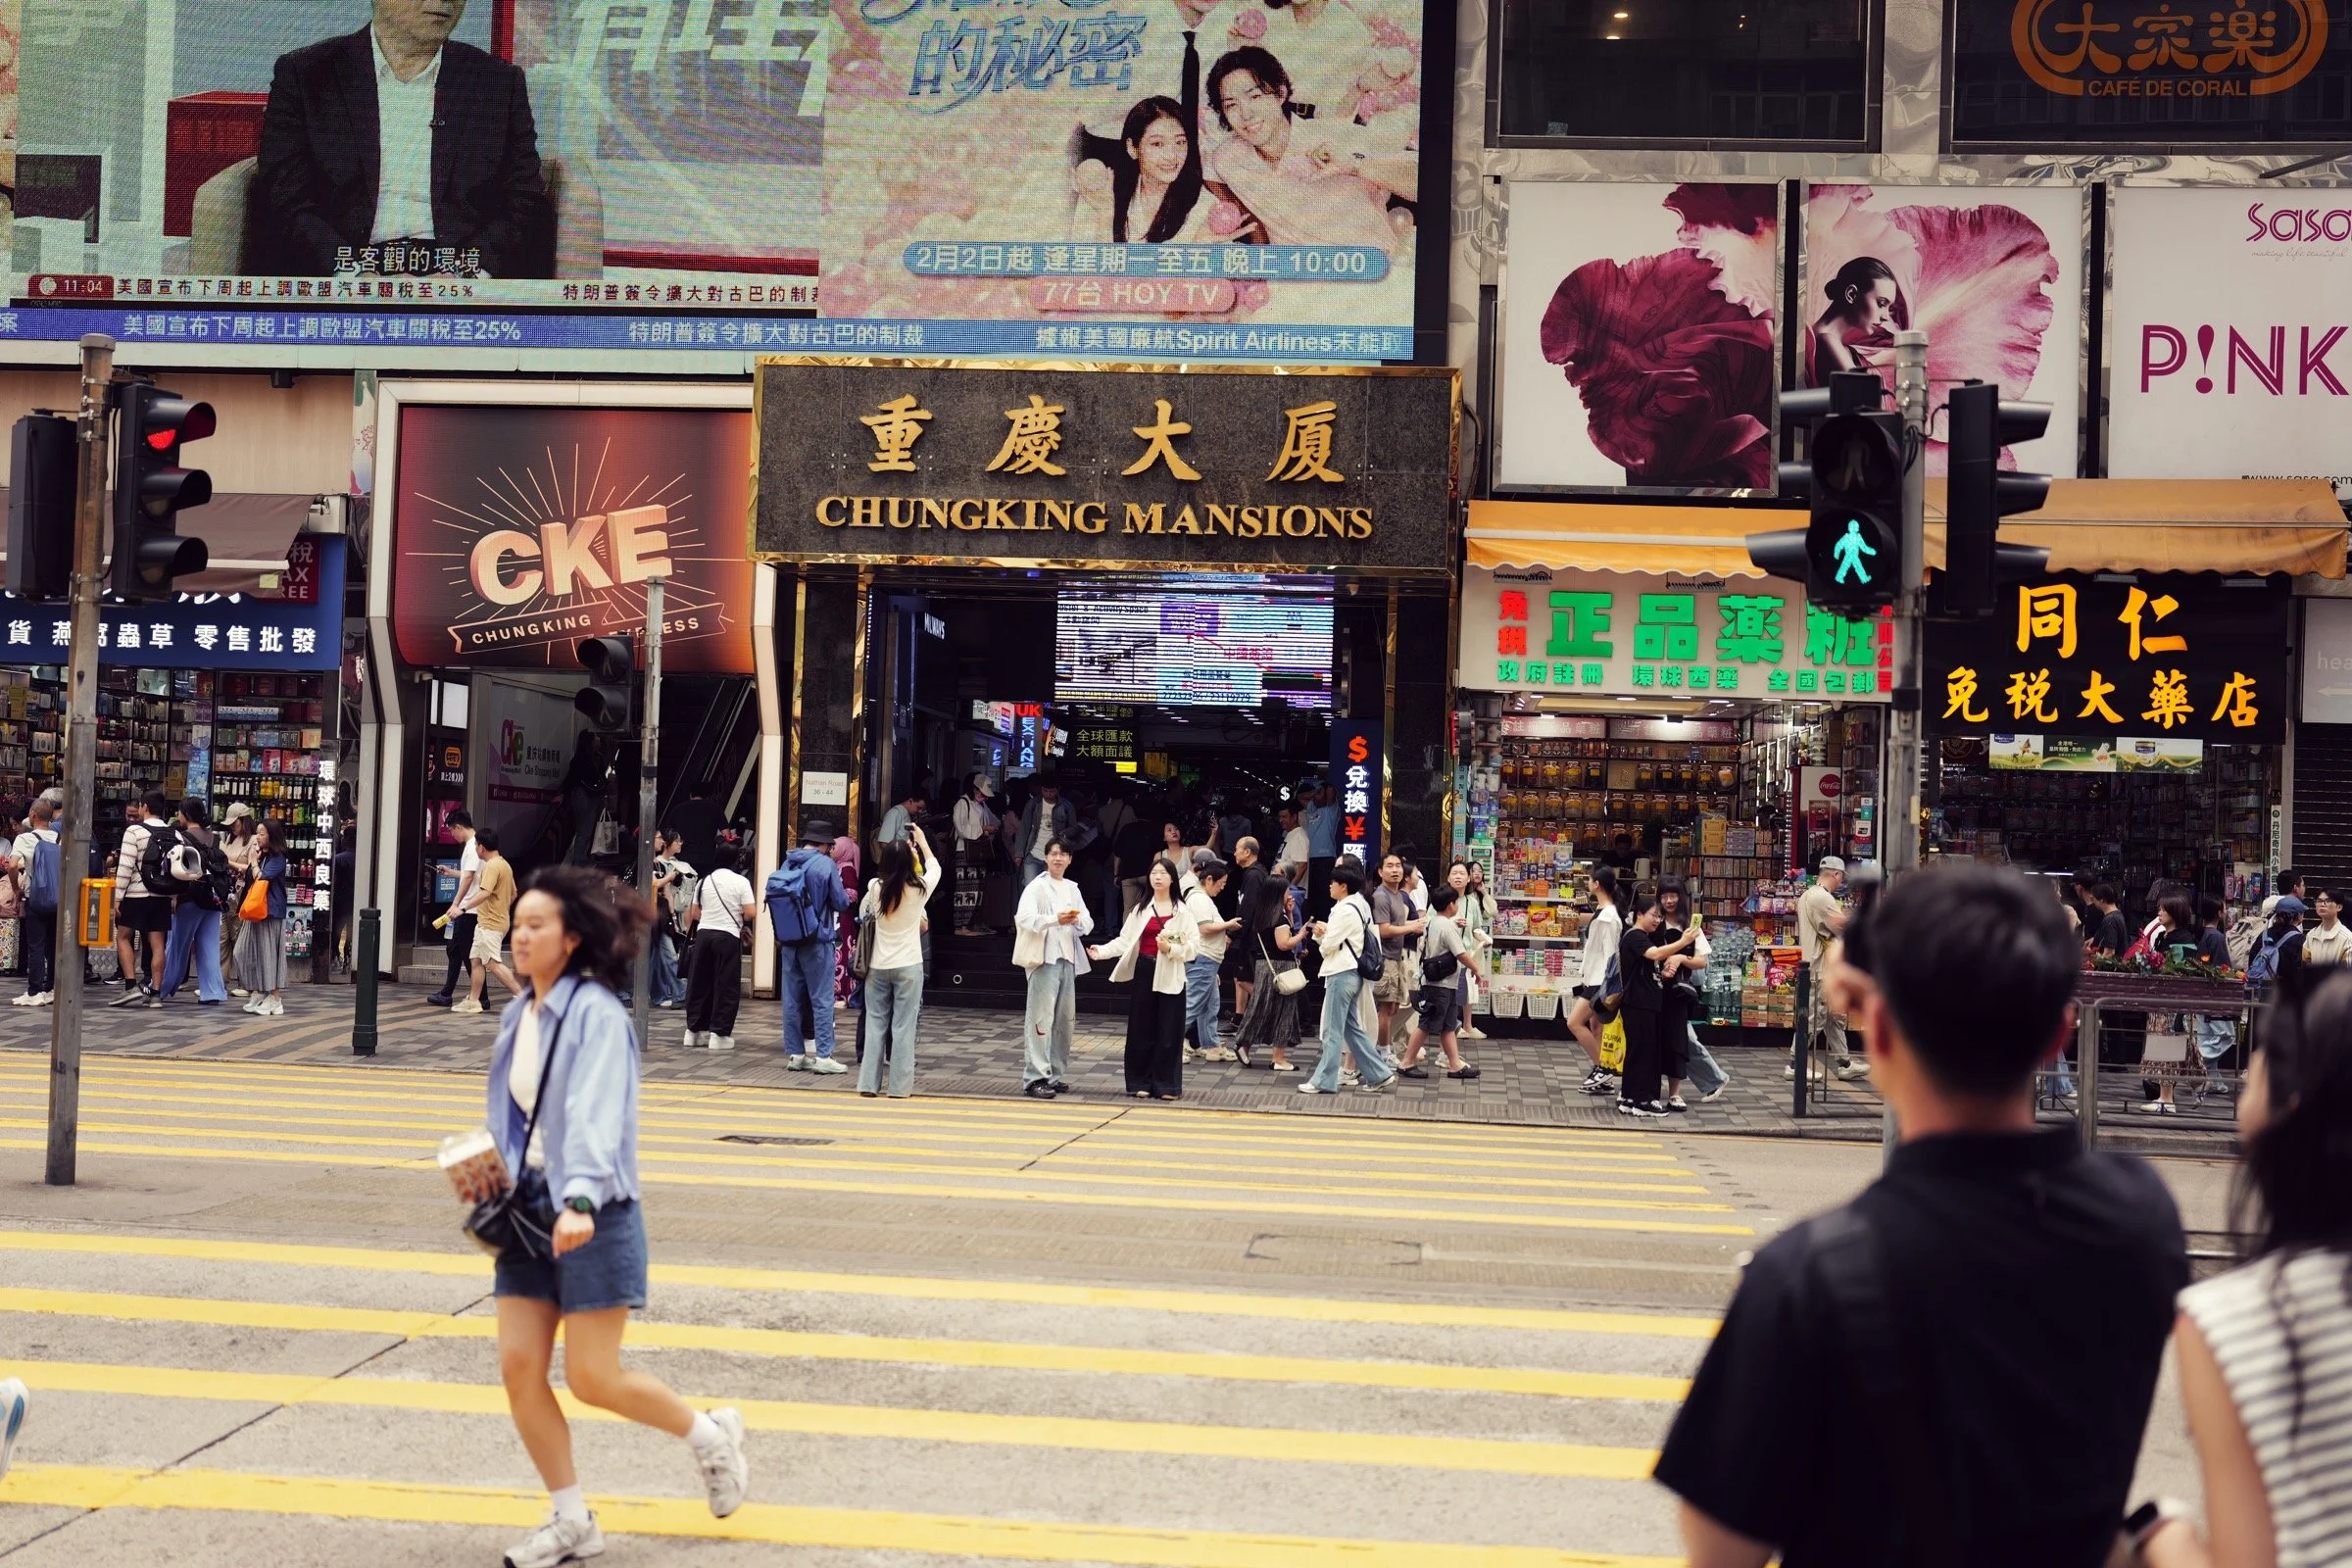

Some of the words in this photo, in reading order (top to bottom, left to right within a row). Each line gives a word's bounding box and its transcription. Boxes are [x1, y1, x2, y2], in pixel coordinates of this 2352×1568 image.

[906, 11, 1148, 114] 的秘密
[2088, 76, 2139, 96] CAFÉ
[2146, 80, 2173, 96] DE
[2178, 79, 2247, 96] CORAL
[333, 246, 481, 275] 是客觀的環境
[916, 246, 1033, 271] 2月2日起
[1043, 246, 1213, 274] 逢星期一至五
[1222, 249, 1278, 274] 晚上
[1290, 252, 1366, 273] 10:00
[63, 279, 103, 293] 11:04
[1044, 281, 1100, 307] 77台
[1113, 283, 1170, 305] HOY
[1183, 284, 1218, 306] TV
[815, 495, 1107, 535] CHUNGKING
[1121, 501, 1372, 539] MANSIONS
[470, 503, 673, 607] CKE
[8, 618, 32, 647] 貨
[194, 623, 318, 655] 零售批發
[471, 613, 592, 646] CHUNGKING
[2016, 583, 2188, 661] 同仁
[1496, 660, 1603, 684] 政府註冊
[1766, 668, 1876, 693] 全國包郵
[1076, 729, 1133, 742] 全球匯款
[1076, 745, 1133, 759] 大額面議
[313, 760, 336, 912] 環球中西良藥
